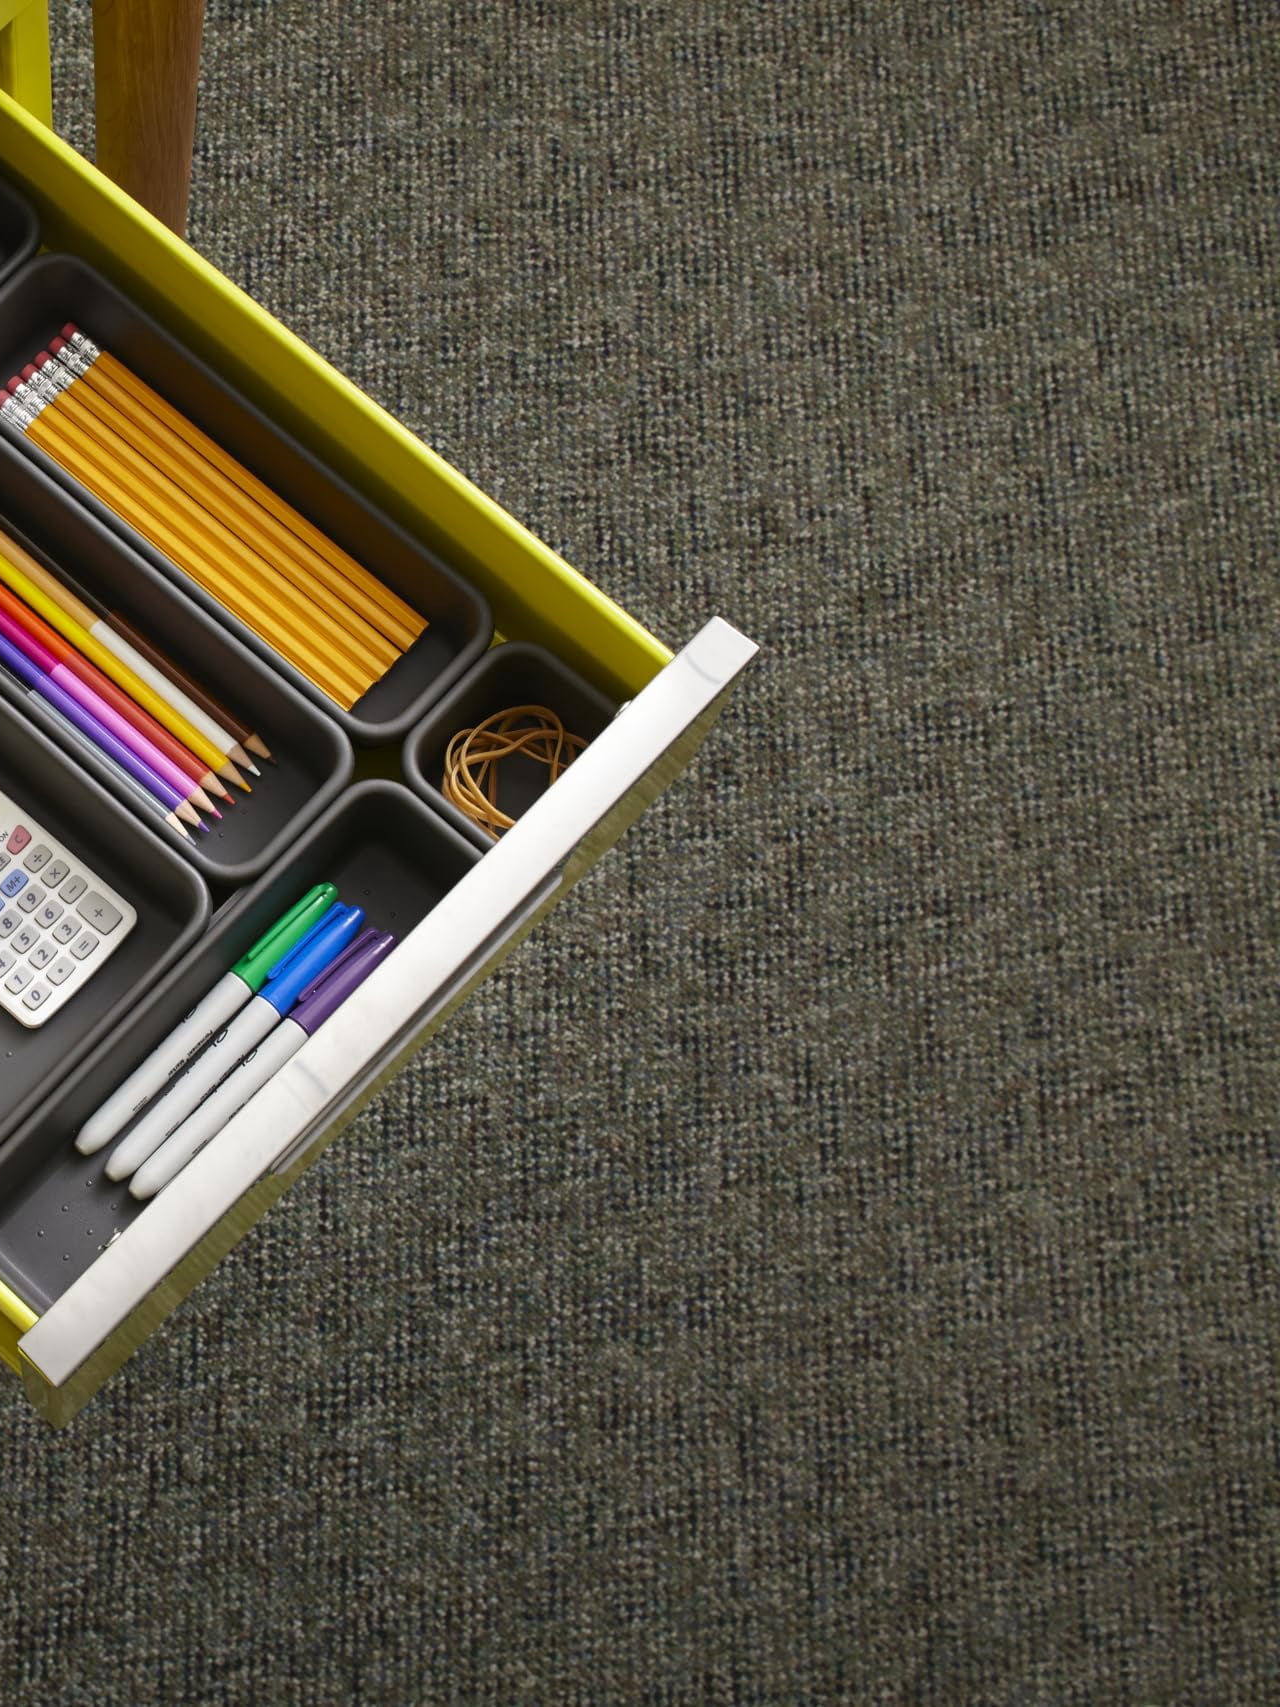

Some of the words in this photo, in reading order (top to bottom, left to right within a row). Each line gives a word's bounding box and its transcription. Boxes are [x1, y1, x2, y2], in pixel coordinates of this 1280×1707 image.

[14, 835, 24, 845] C
[6, 875, 21, 893] M+
[26, 893, 37, 905] 9
[44, 907, 55, 920] 6
[2, 917, 13, 930] 8
[61, 923, 73, 936] 3
[19, 932, 31, 946] 5
[37, 948, 49, 961] 2
[13, 974, 23, 985] 1
[30, 989, 41, 1002] 0
